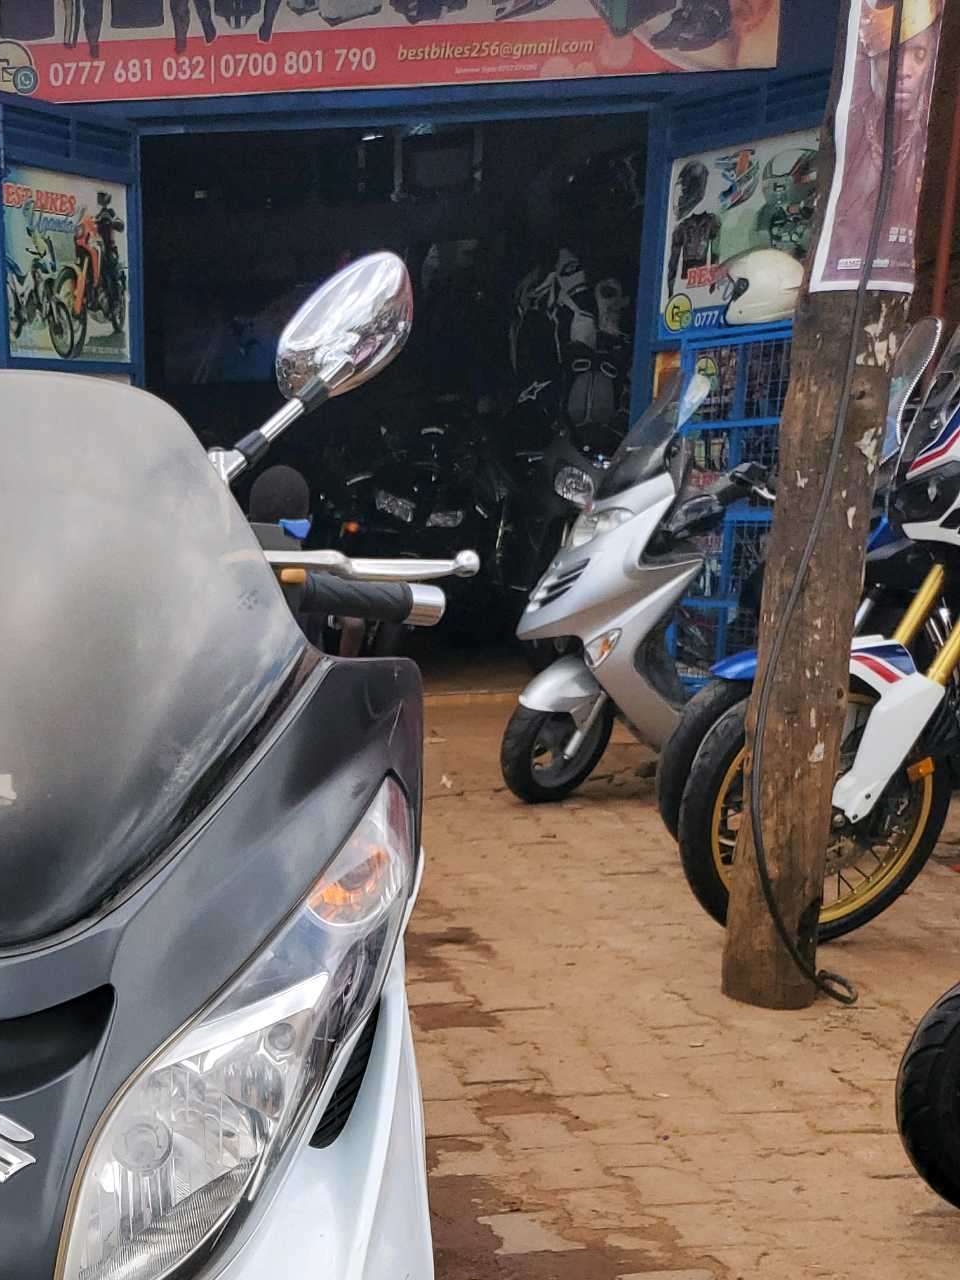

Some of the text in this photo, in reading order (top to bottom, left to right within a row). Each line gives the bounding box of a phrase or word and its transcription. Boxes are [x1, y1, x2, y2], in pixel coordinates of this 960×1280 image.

[397, 39, 595, 61] bestbikes256@gmail.com
[49, 48, 376, 86] 0777 681 032 0700 801 790
[694, 311, 719, 327] 0777
